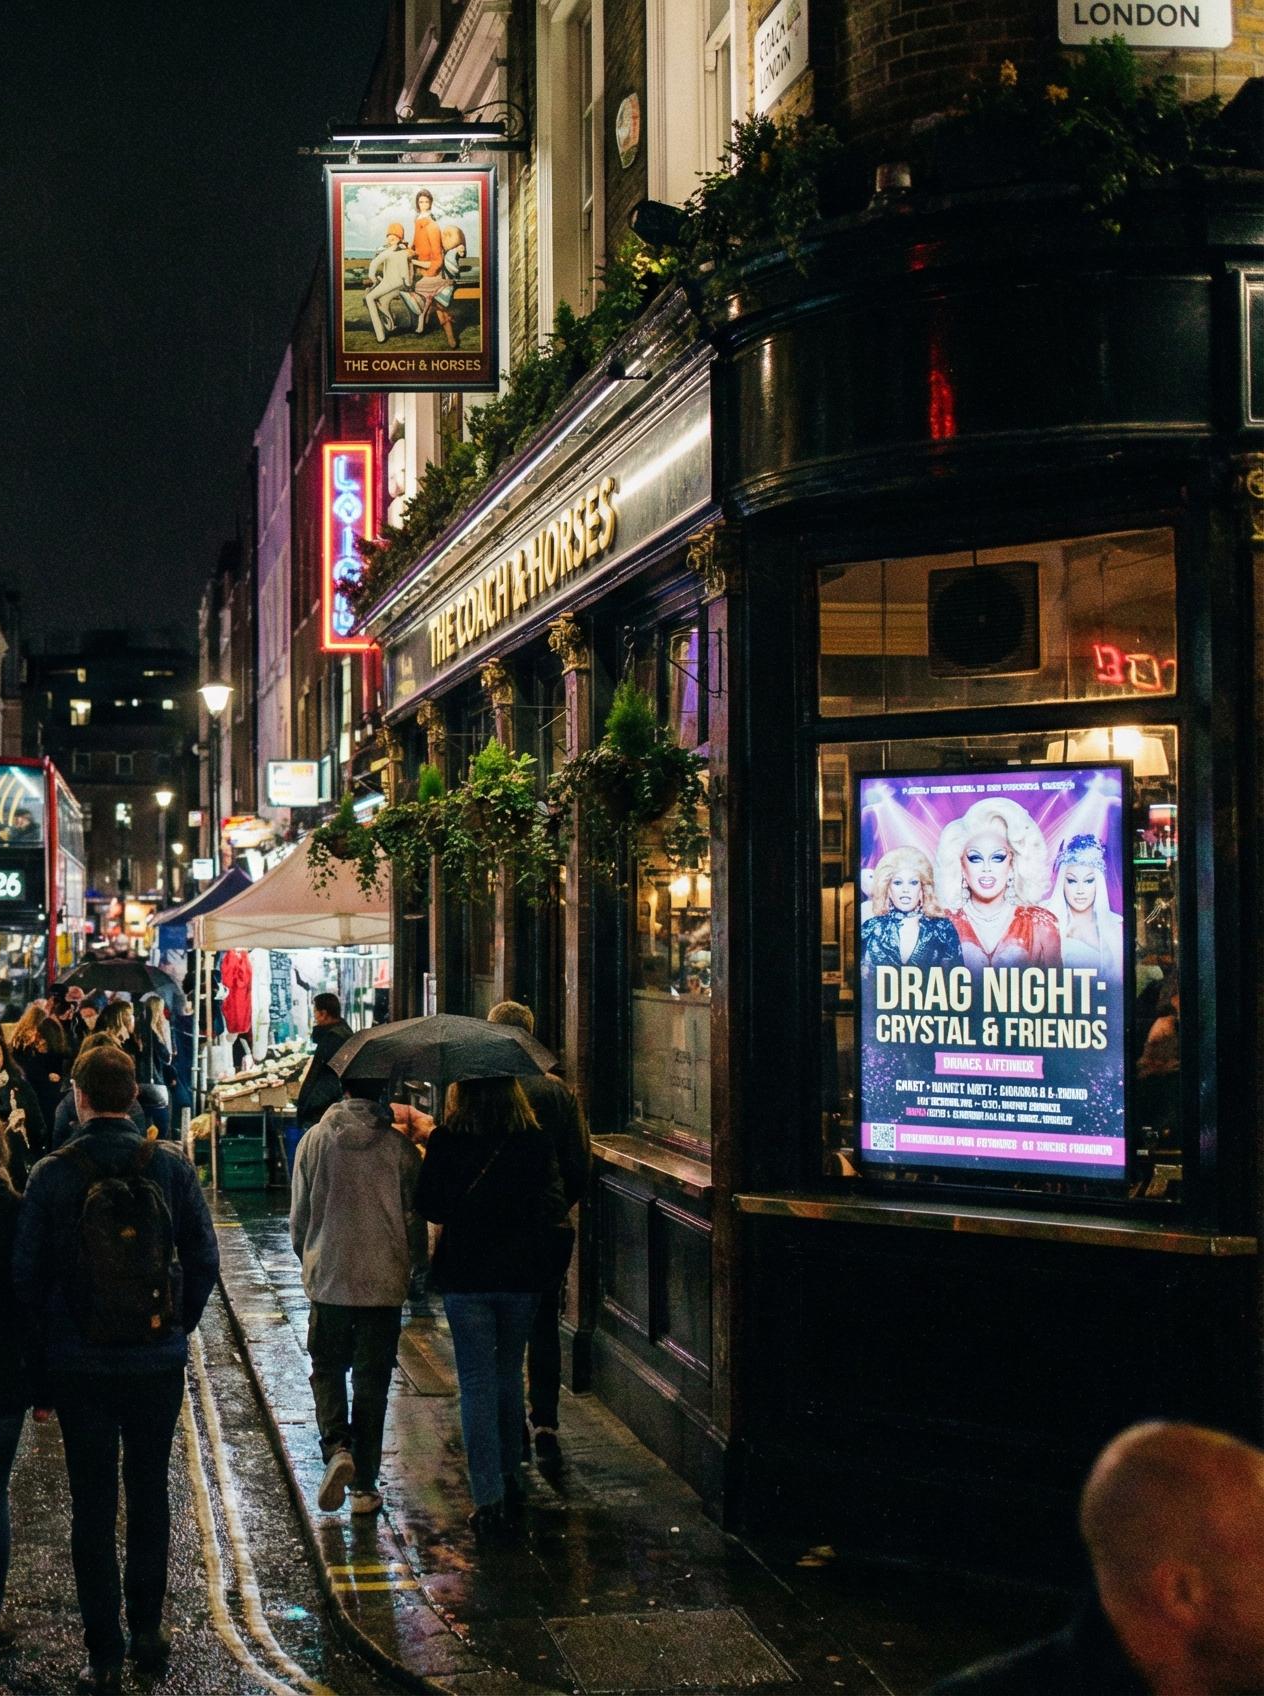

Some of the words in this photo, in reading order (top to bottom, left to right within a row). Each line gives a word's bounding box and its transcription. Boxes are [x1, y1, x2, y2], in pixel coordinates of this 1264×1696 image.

[1074, 3, 1200, 28] LONDON
[344, 360, 368, 371] THE
[372, 359, 415, 371] COACH
[419, 360, 428, 371] &
[428, 605, 456, 667] THE
[456, 564, 510, 648] COACH
[511, 549, 530, 611] &
[876, 966, 972, 1011] DRAG
[983, 967, 1107, 1015] NIGHT:
[876, 1014, 976, 1046] CRYSTAL
[983, 1017, 999, 1047] &
[1005, 1017, 1108, 1050] FRIENDS
